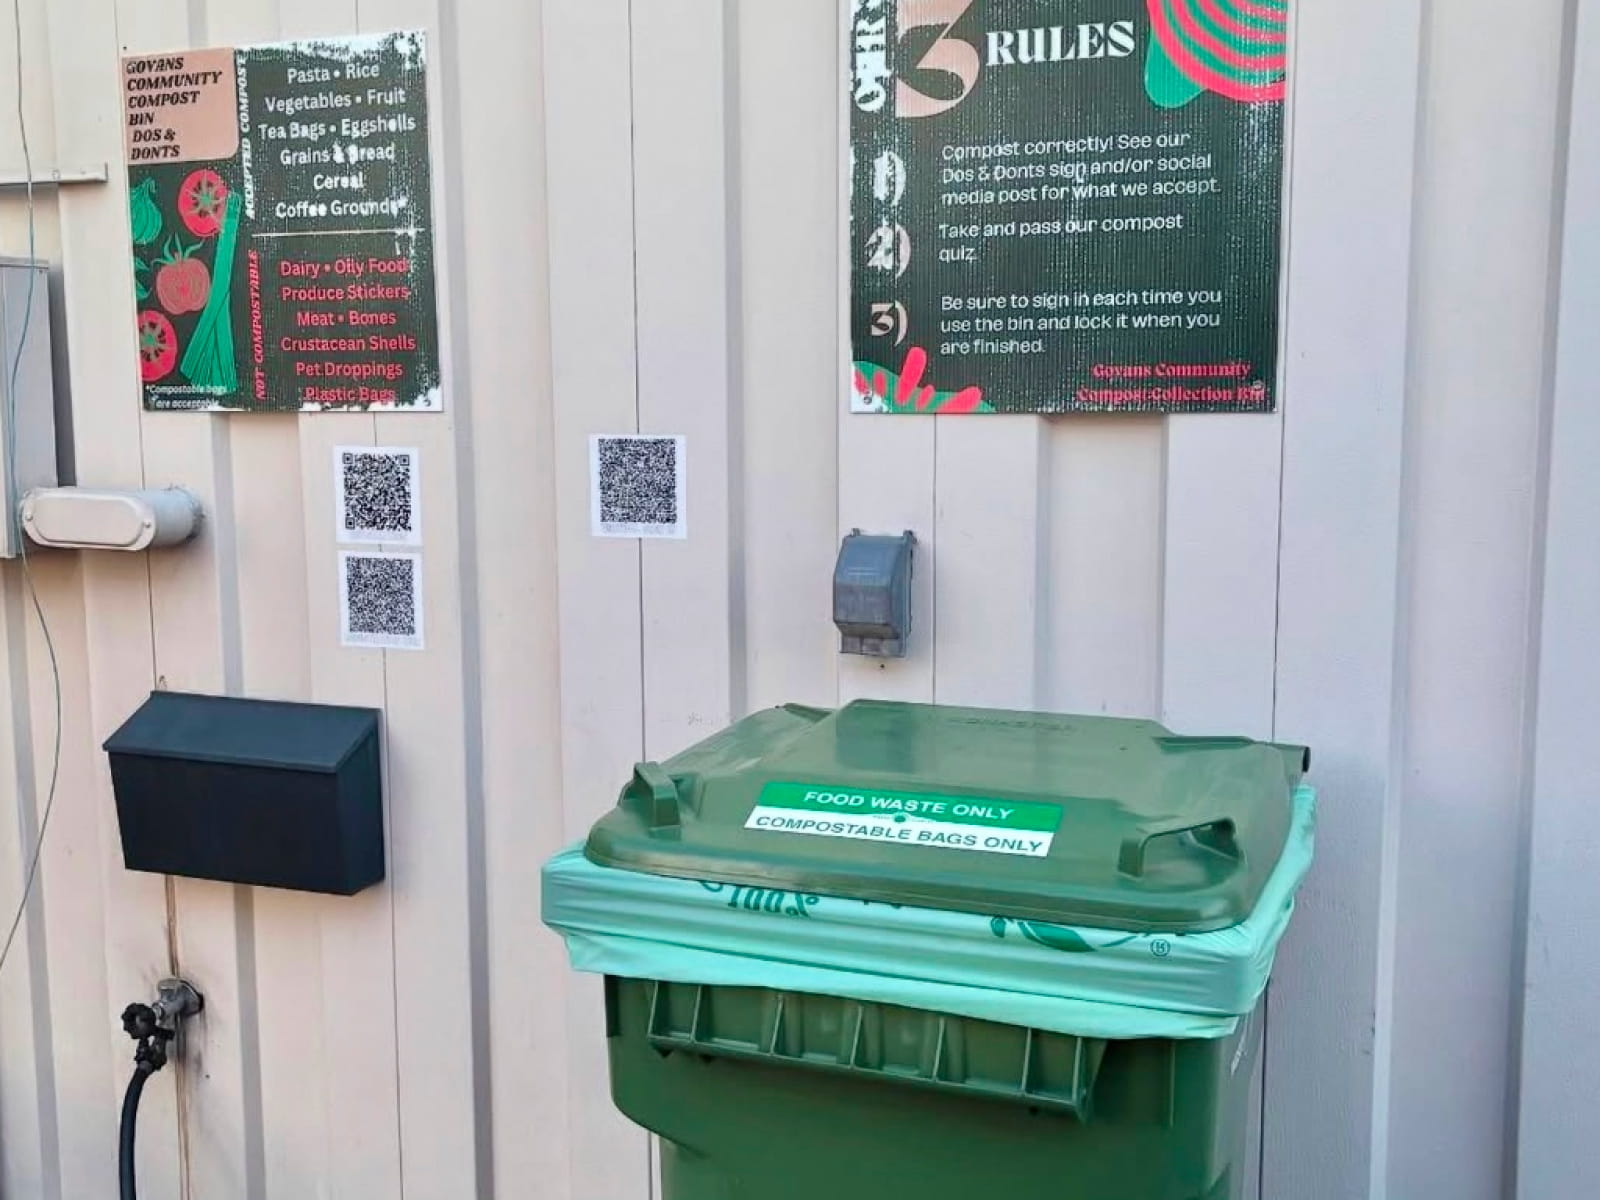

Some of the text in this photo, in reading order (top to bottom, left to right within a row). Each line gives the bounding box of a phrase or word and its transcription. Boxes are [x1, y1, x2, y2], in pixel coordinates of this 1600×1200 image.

[126, 57, 184, 74] GOVANS
[895, 0, 980, 118] 3
[985, 20, 1136, 67] RULES
[127, 71, 222, 91] COMMUNITY
[287, 62, 380, 84] Pasta Rice
[128, 90, 200, 108] COMPOST
[264, 87, 406, 116] Vegetables Fruit
[128, 111, 155, 126] BIN
[257, 113, 417, 141] Tea Bags Eggshells
[132, 127, 176, 142] DOS &
[131, 145, 180, 160] DONTS
[280, 147, 330, 166] Grains
[942, 141, 1020, 161] Compost
[1024, 135, 1114, 154] correctly!
[1118, 134, 1152, 150] See
[1156, 133, 1191, 148] our
[943, 152, 1212, 184] Dos & Donts sign and/or social
[314, 172, 364, 190] Cereal
[941, 188, 995, 205] media
[998, 187, 1038, 204] post
[1041, 184, 1069, 200] for
[1072, 182, 1118, 199] what
[1121, 181, 1148, 196] we
[275, 200, 327, 218] Coffee
[938, 223, 979, 239] Take
[983, 220, 1015, 237] and
[1019, 220, 1061, 238] pass
[1065, 219, 1097, 234] our
[1101, 213, 1184, 232] compost
[280, 260, 320, 278] Dairy
[334, 257, 364, 277] Oily
[282, 283, 409, 301] Produce Stickers
[248, 249, 266, 400] NOT COMPOSTABLE
[297, 311, 397, 327] Meat Bones
[871, 289, 1222, 347] 3) Be sure to sign in each time you
[941, 313, 1220, 333] use the bin and lock it when you
[281, 336, 416, 351] Crustacean Shells
[940, 339, 1046, 355] are finished.
[296, 361, 403, 380] Pet Droppings
[1092, 361, 1251, 378] Govans Community
[305, 387, 397, 404] Plastic Bags
[1078, 386, 1146, 404] Compost
[1151, 385, 1232, 402] Collection
[803, 791, 865, 807] FOOD
[870, 796, 947, 815] WASTE
[952, 802, 1015, 820] ONLY
[756, 815, 912, 841] COMPOSTABLE
[916, 829, 978, 847] BAGS
[983, 836, 1043, 853] ONLY
